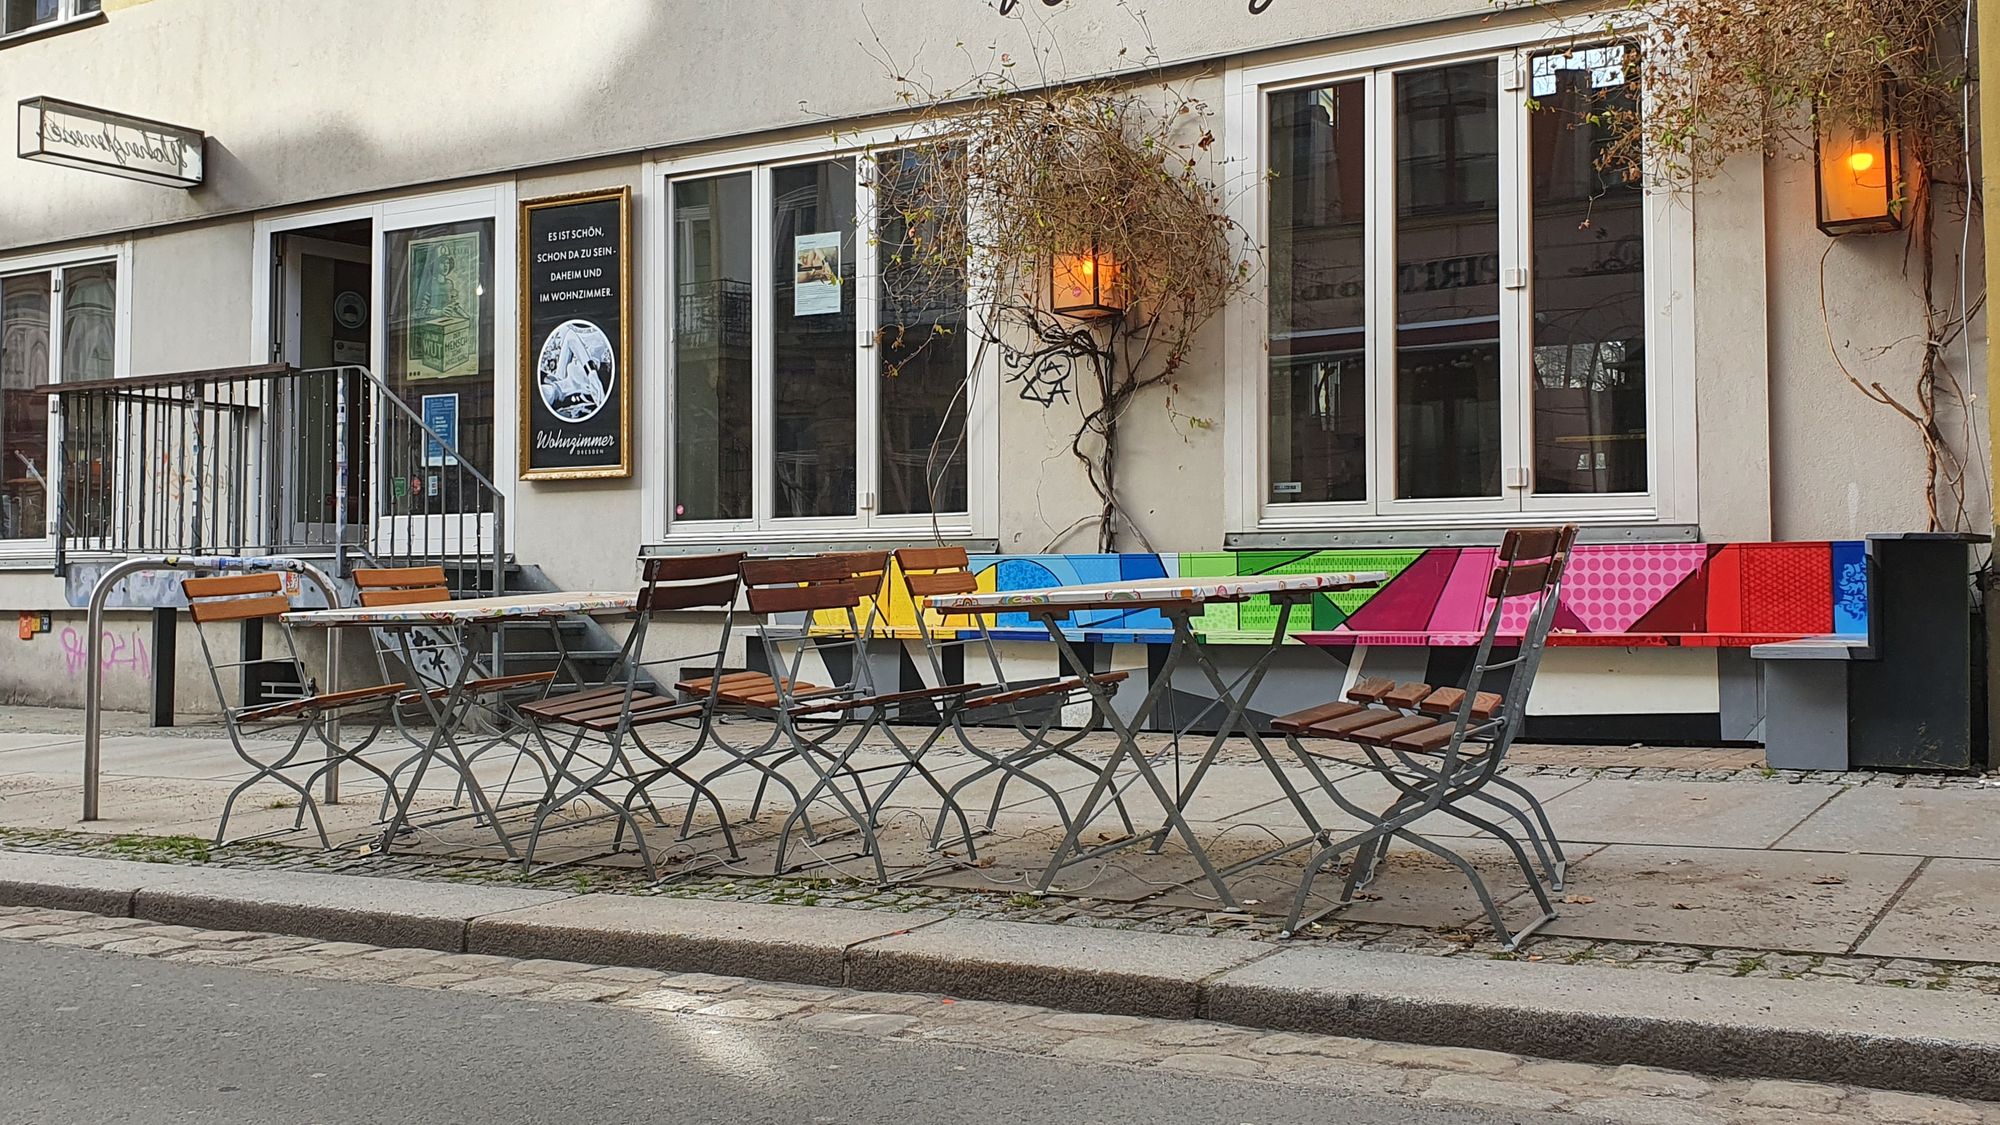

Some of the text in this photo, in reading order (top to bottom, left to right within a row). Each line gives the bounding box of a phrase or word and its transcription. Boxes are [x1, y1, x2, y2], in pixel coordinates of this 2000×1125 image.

[548, 226, 605, 242] ES IST SCHÖN,
[537, 251, 567, 263] SCHON
[568, 249, 580, 260] DA
[580, 248, 592, 259] ZU
[550, 268, 602, 282] DAHEIM UND
[539, 287, 614, 303] IM WOHNZIMMER.
[423, 339, 443, 360] WUT
[536, 428, 615, 455] Wohnzimmer
